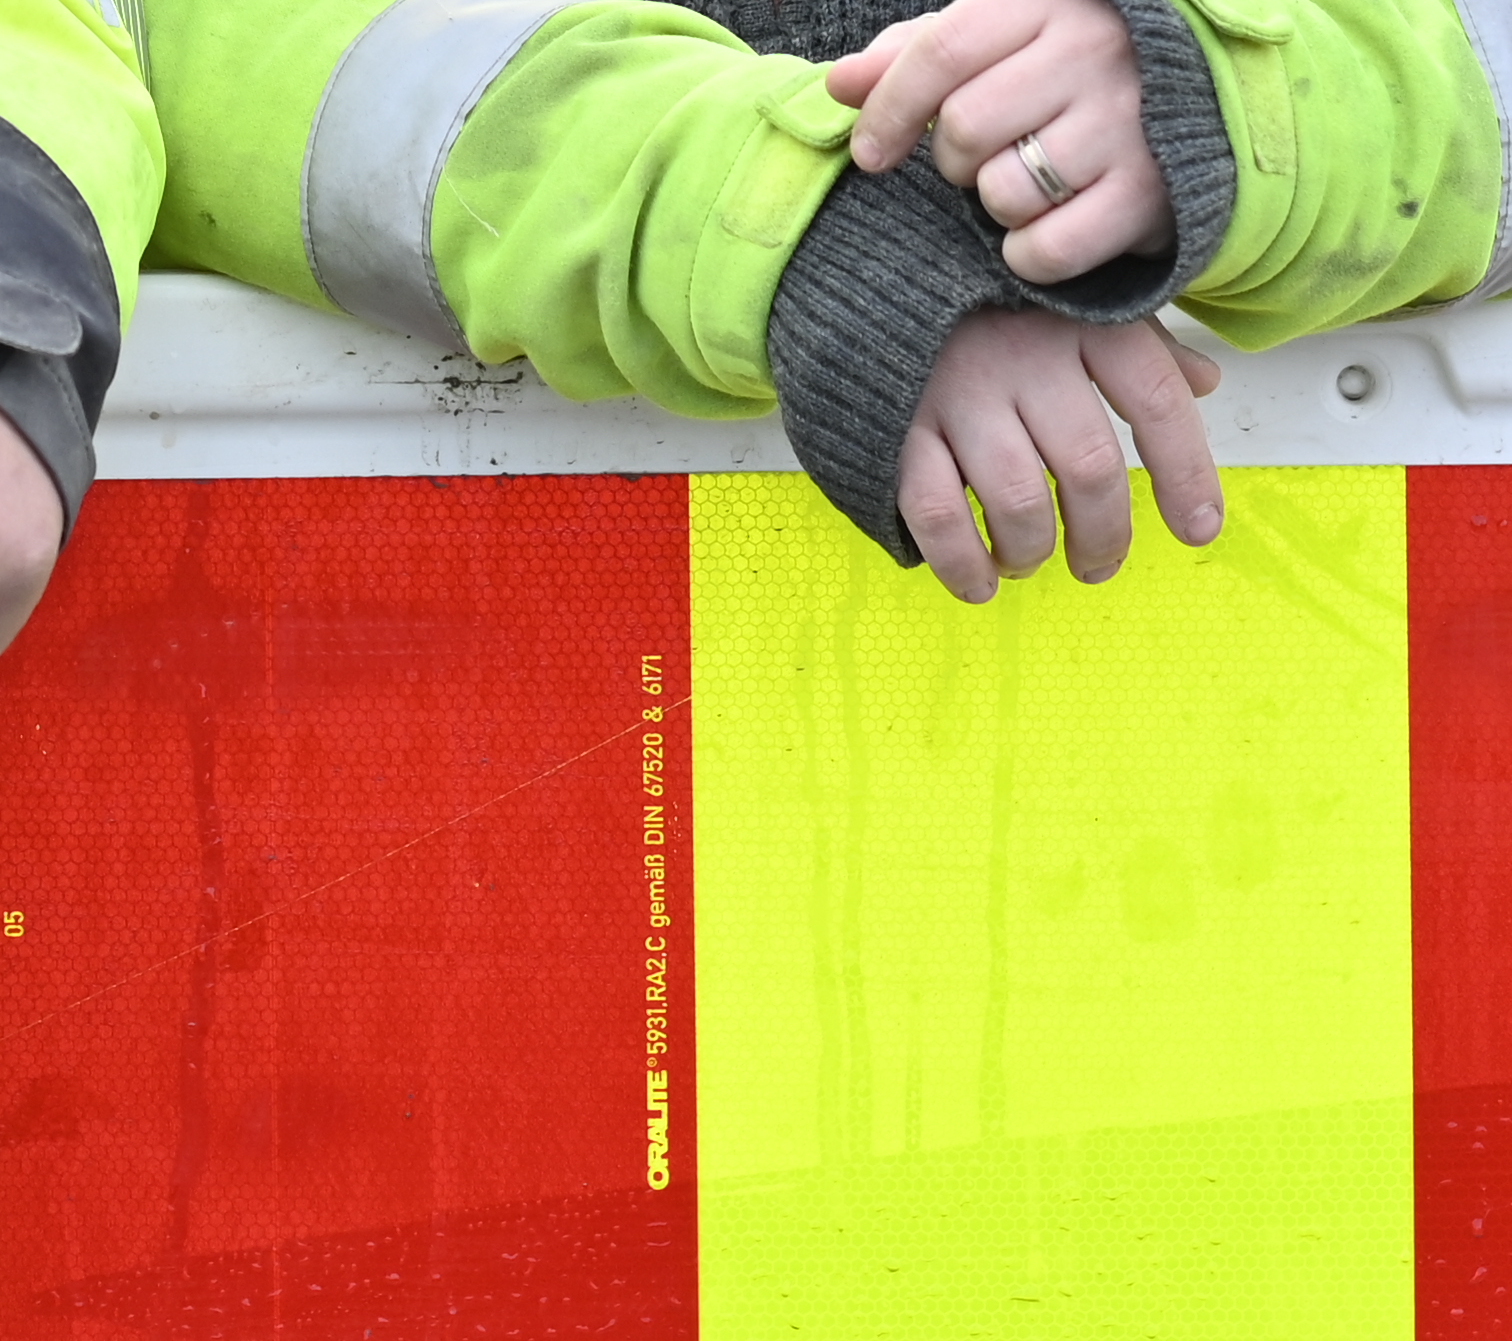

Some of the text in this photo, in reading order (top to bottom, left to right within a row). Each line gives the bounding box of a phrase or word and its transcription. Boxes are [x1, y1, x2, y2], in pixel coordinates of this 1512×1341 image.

[641, 655, 663, 695] 6171
[642, 706, 664, 723] &
[642, 732, 664, 797] 67520
[643, 805, 665, 845] DIN
[644, 854, 672, 928] gemäß
[3, 911, 25, 937] 05
